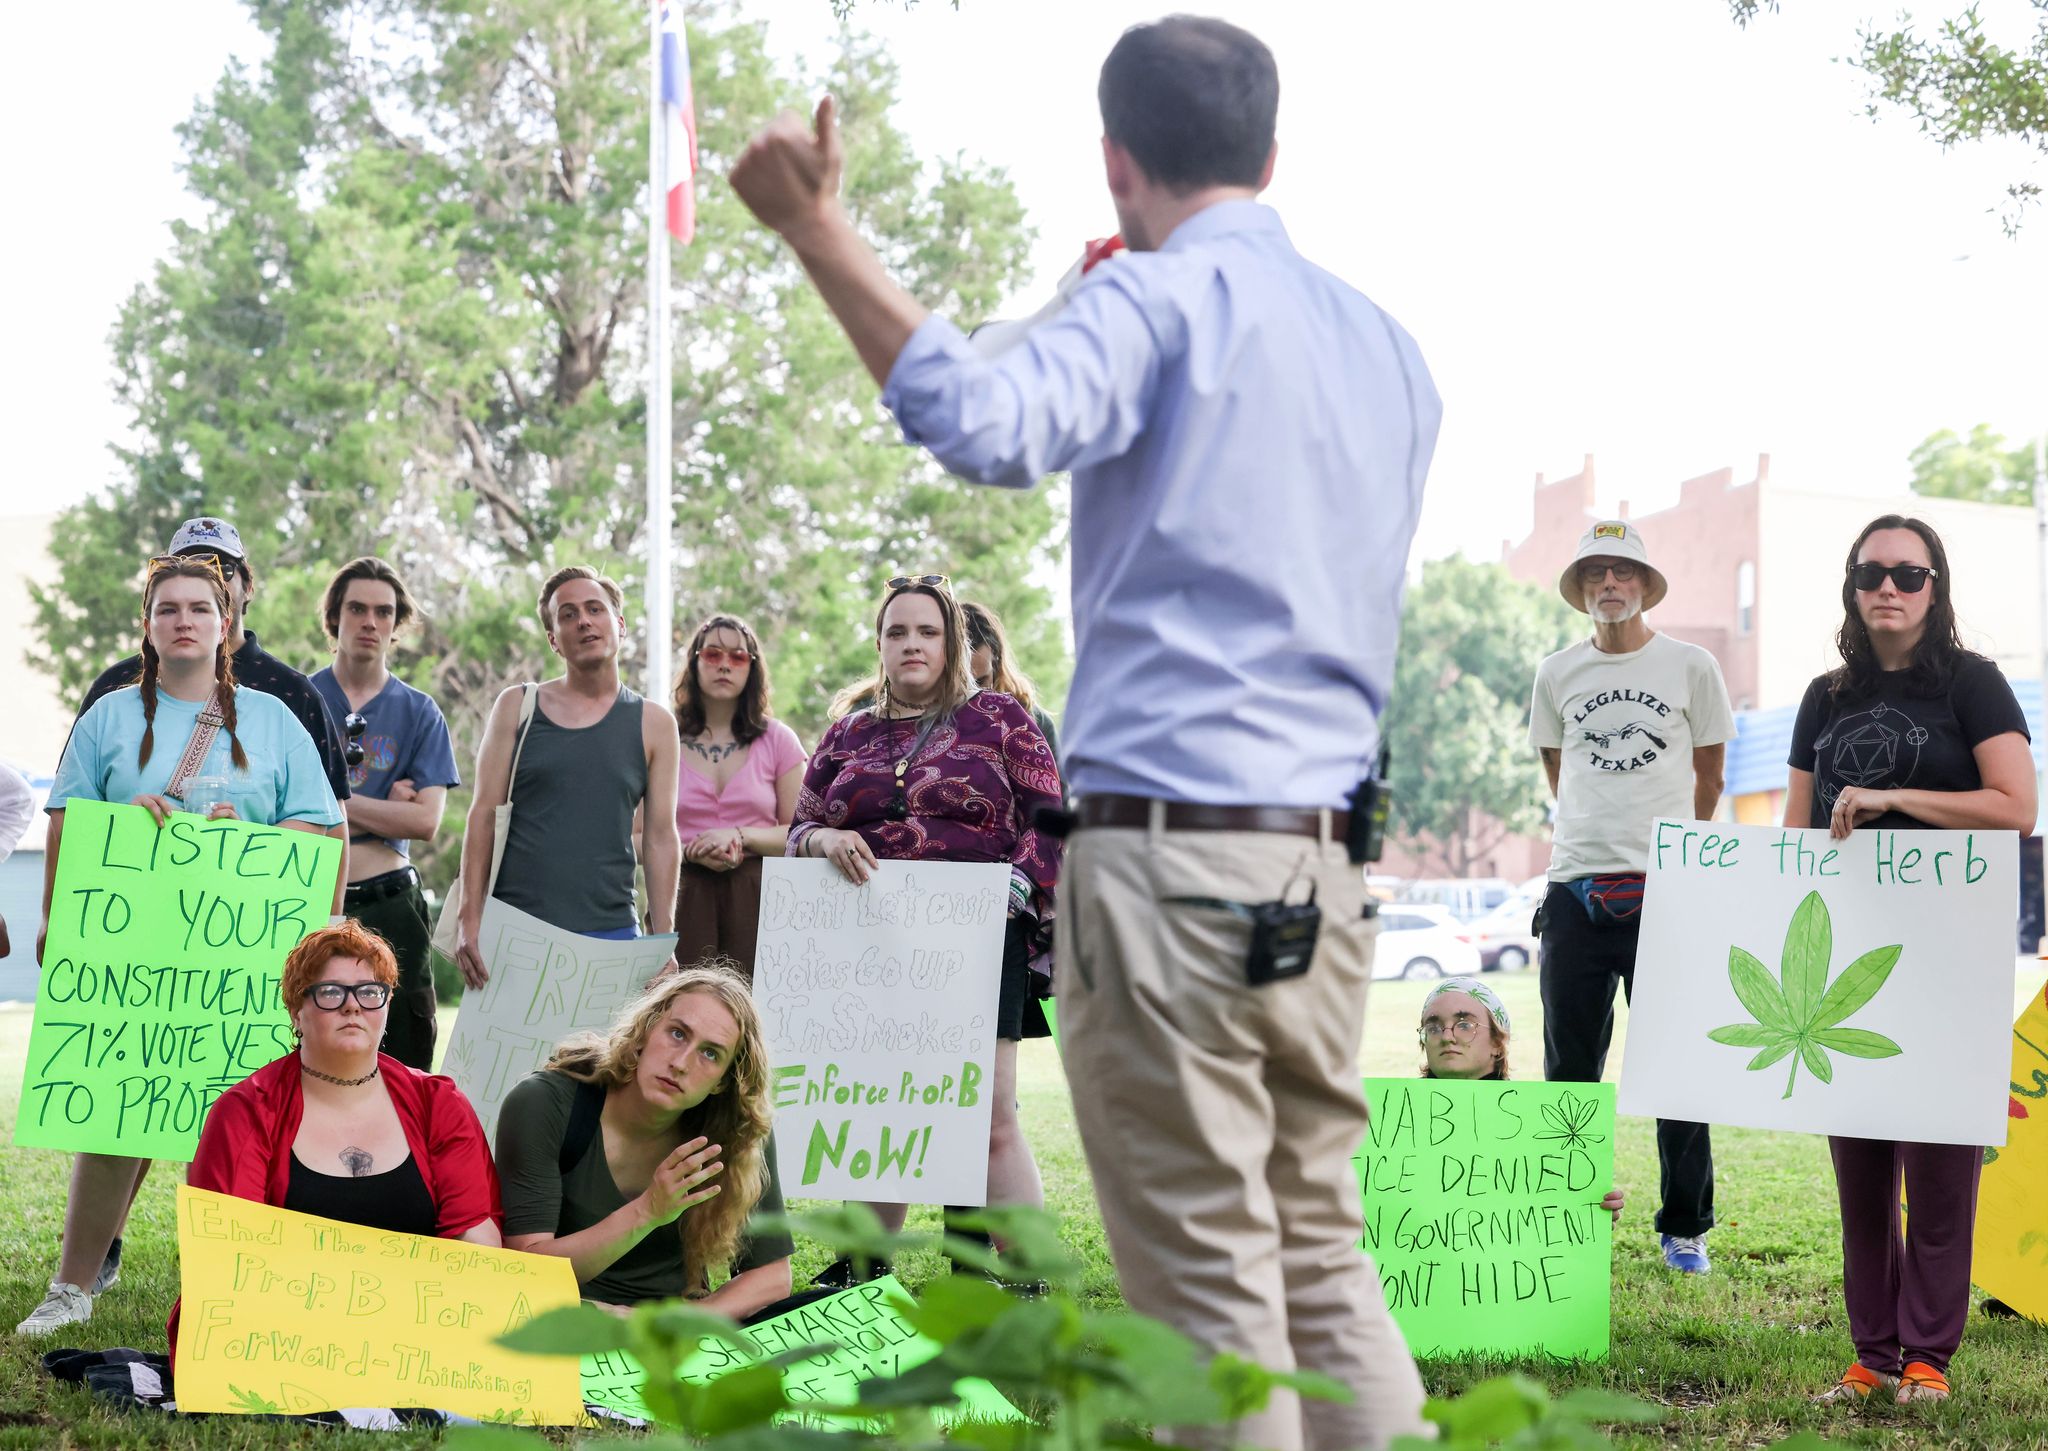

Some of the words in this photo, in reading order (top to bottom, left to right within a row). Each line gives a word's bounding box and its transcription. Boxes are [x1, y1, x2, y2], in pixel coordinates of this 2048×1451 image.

[1574, 689, 1671, 724] LEGALIZE
[1590, 749, 1657, 772] TEXAS
[102, 814, 320, 888] LISTEN
[1656, 822, 1740, 870] Free
[1770, 831, 1841, 877] the
[1877, 831, 1988, 886] Herb
[73, 888, 132, 938] TO
[179, 889, 308, 951] YOUR
[857, 873, 926, 929] Let
[760, 937, 851, 991] Votes
[856, 945, 901, 989] Go
[42, 1021, 128, 1077] 71%
[141, 1022, 213, 1068] VOTE
[221, 1021, 292, 1082] YES
[33, 1081, 95, 1127] TO
[772, 1063, 889, 1108] Enforce
[1441, 1150, 1596, 1196] DENIED
[188, 1197, 283, 1246] End
[304, 1222, 367, 1256] The
[1394, 1201, 1602, 1254] GOVERNMENT
[346, 1270, 387, 1317] B
[415, 1280, 484, 1329] For
[503, 1291, 534, 1335] A
[1461, 1255, 1573, 1306] HIDE
